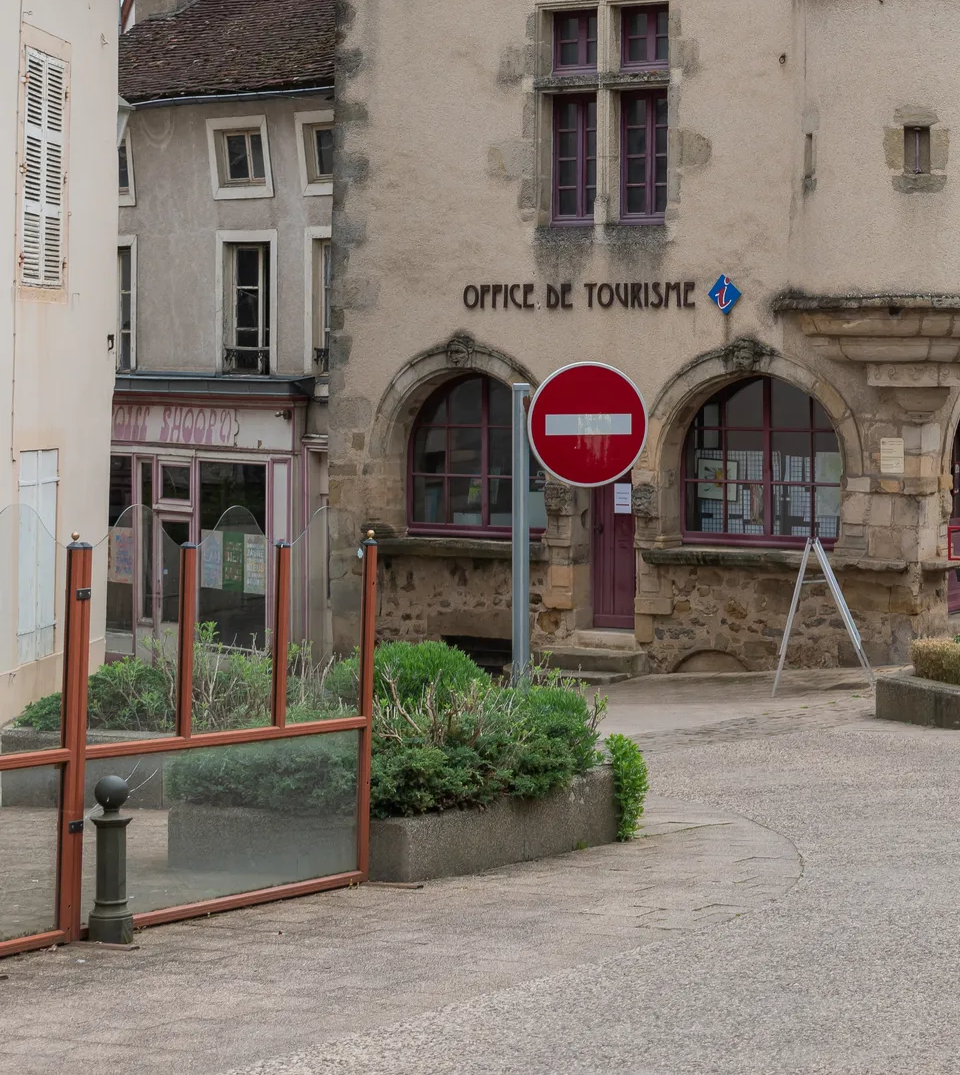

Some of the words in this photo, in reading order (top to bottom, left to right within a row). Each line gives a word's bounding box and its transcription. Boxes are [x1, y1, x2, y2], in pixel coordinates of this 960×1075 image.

[463, 283, 535, 309] OFFICE
[546, 282, 573, 309] DE
[584, 281, 696, 309] TOURISME
